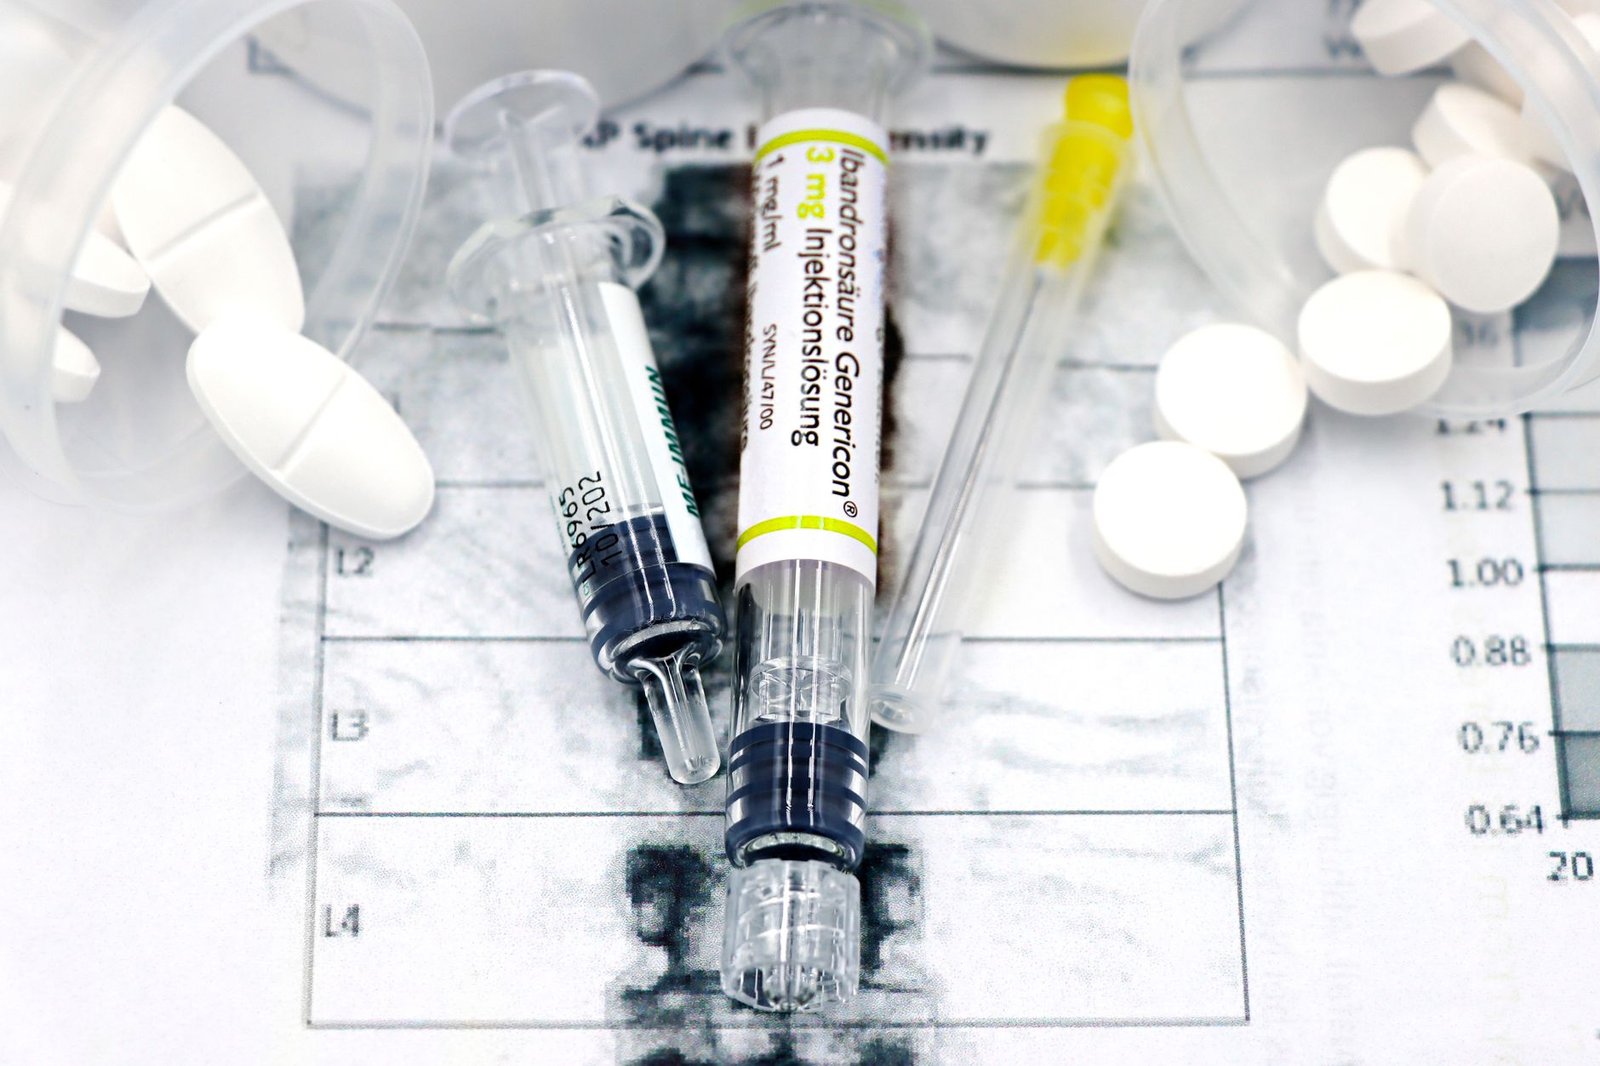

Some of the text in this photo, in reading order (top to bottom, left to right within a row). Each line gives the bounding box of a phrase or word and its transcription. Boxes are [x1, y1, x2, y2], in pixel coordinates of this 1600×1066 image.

[632, 123, 733, 152] Spine
[762, 153, 785, 253] 1 mg/ml
[834, 149, 866, 342] Ibandronsäure
[790, 146, 834, 447] 3 mg Injektionslösung
[759, 323, 777, 430] SYN/L/47/00
[1440, 480, 1515, 511] 1.12
[558, 487, 596, 583] LR6965
[336, 546, 375, 577] L2
[1447, 558, 1524, 588] 1.00
[1450, 635, 1532, 668] 0.88
[328, 709, 370, 742] L3
[1459, 721, 1541, 754] 0.76
[1465, 803, 1544, 836] 0.64
[1546, 850, 1594, 881] 20
[321, 903, 363, 938] L4
